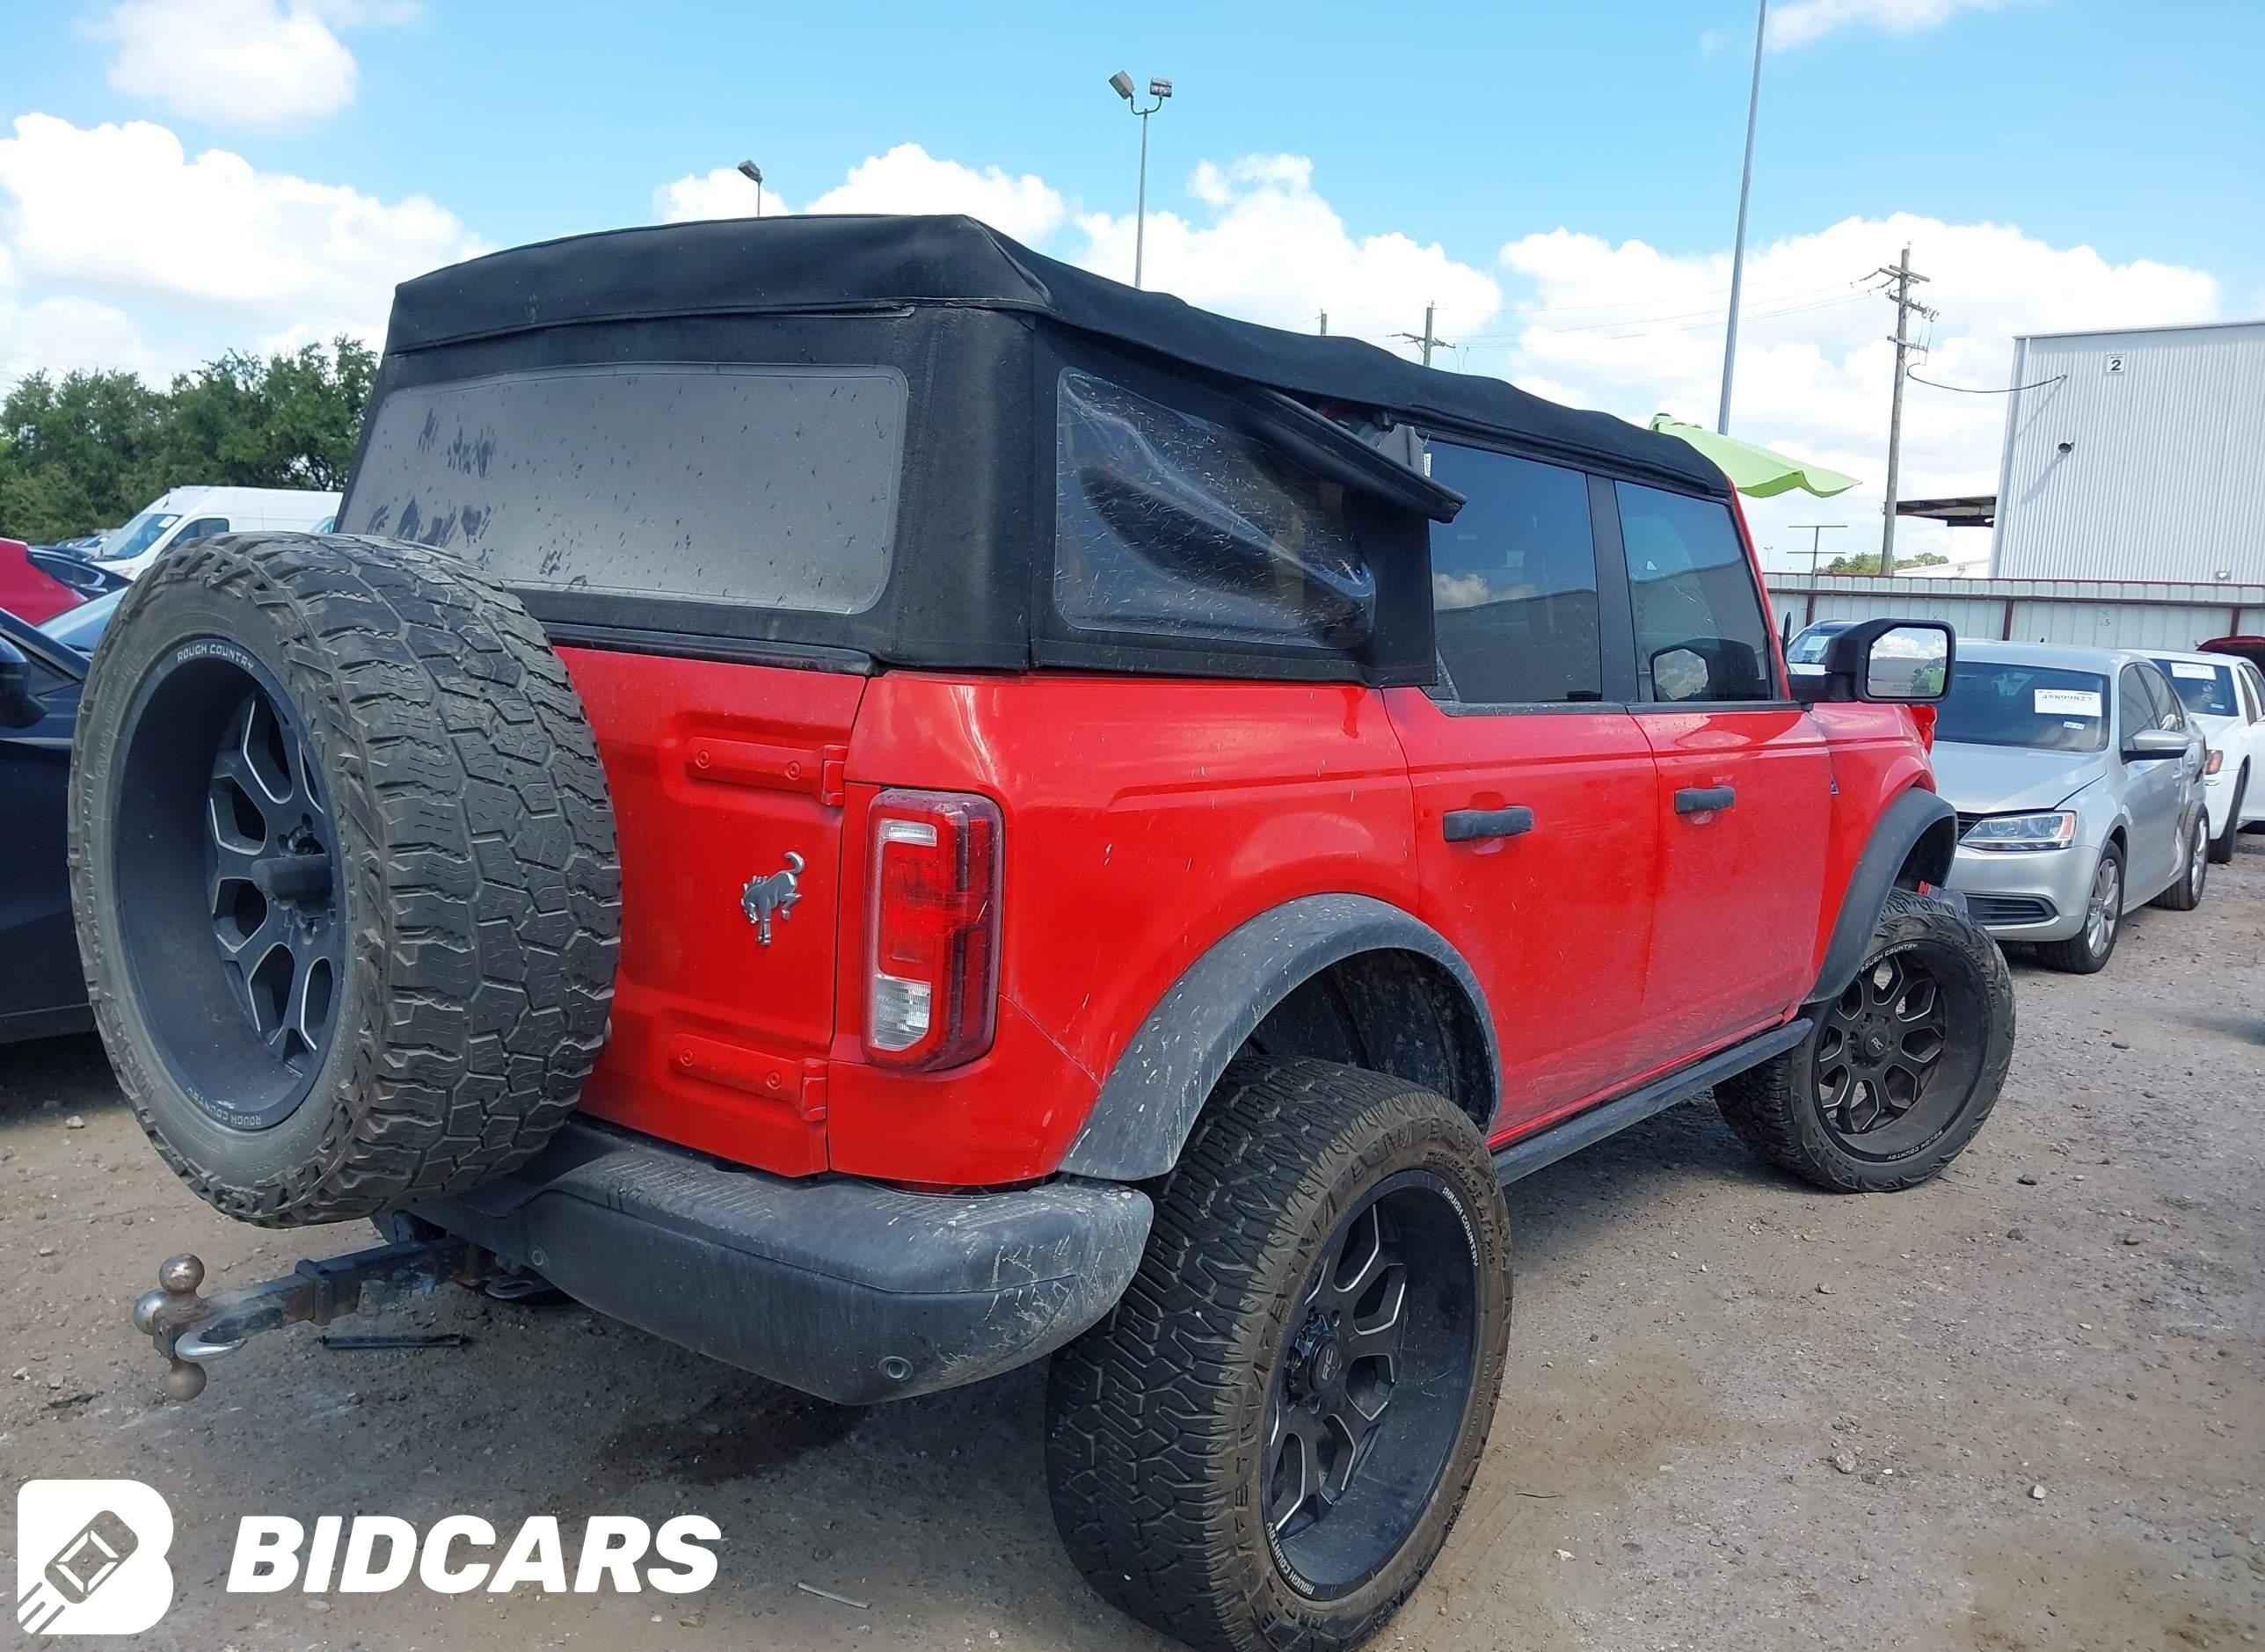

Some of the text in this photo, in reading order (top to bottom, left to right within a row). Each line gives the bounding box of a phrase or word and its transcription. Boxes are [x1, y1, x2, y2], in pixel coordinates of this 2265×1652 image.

[2110, 359, 2121, 371] 2
[177, 644, 254, 671] ROUGH COUNTRY
[1860, 942, 1918, 973] ROUGH COUNTRY
[230, 1113, 262, 1126] ROUGH
[1886, 1129, 1943, 1161] ROUGH COUNTRY
[1441, 1187, 1479, 1267] ROUGH COUNTRY
[1266, 1521, 1315, 1596] ROUGH COUNTRY
